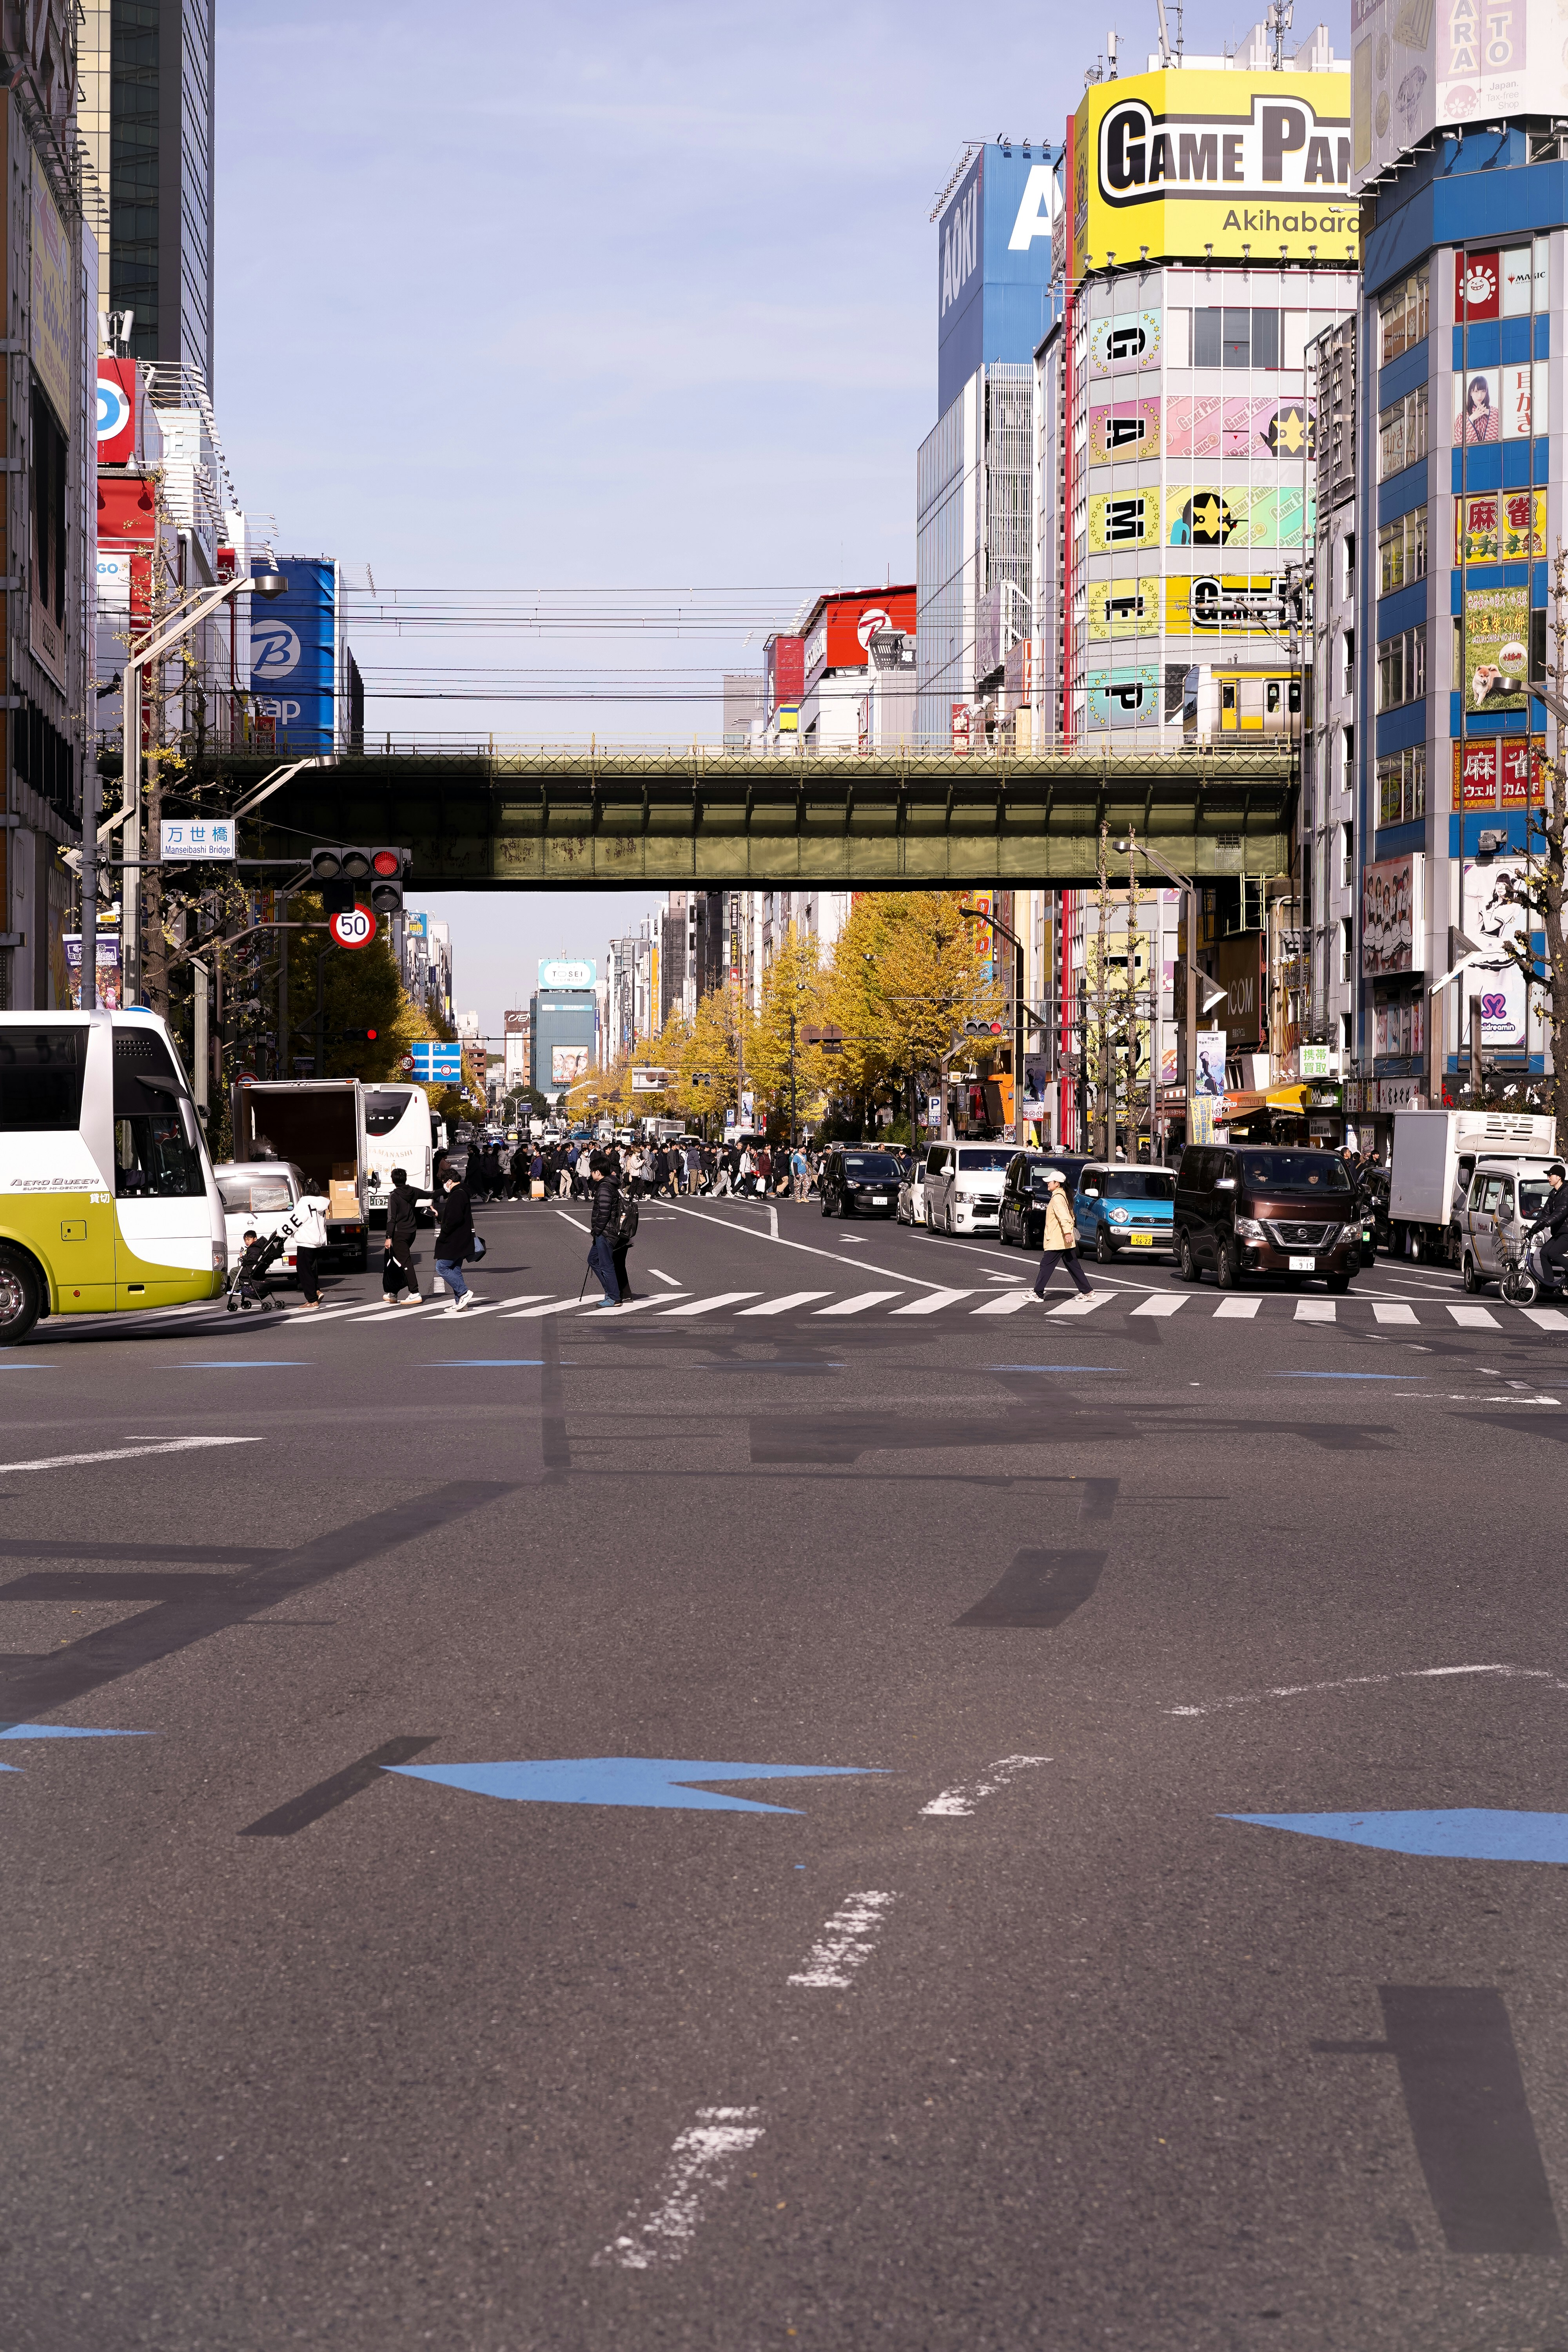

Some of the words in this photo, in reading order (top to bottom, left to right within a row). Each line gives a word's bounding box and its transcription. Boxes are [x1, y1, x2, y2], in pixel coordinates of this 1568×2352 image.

[1490, 81, 1519, 91] Japan.
[1486, 91, 1519, 102] Tax-free
[1498, 101, 1519, 110] Shop
[1107, 110, 1245, 192] GAME
[942, 178, 977, 318] AOKI
[1466, 495, 1537, 534] 麻雀
[1469, 613, 1525, 633] 小豆柴の郷
[1473, 634, 1500, 643] AZUKISHIBA
[1501, 633, 1507, 641] NO
[1509, 632, 1521, 641] SATO
[1464, 749, 1535, 780] 麻雀
[168, 826, 227, 842] 万世橋
[165, 845, 207, 854] Manseibashi
[209, 845, 230, 855] Bridge
[341, 916, 367, 935] 50
[1228, 977, 1253, 1015] ICOM
[1304, 1049, 1327, 1061] 携帯
[1304, 1062, 1327, 1075] 買取
[1414, 1085, 1419, 1094] 24
[931, 1098, 940, 1109] P
[368, 1148, 413, 1158] YAMANASHI
[11, 1178, 50, 1186] AERO
[89, 1193, 110, 1204] 貸切
[1478, 1223, 1488, 1231] Yakult
